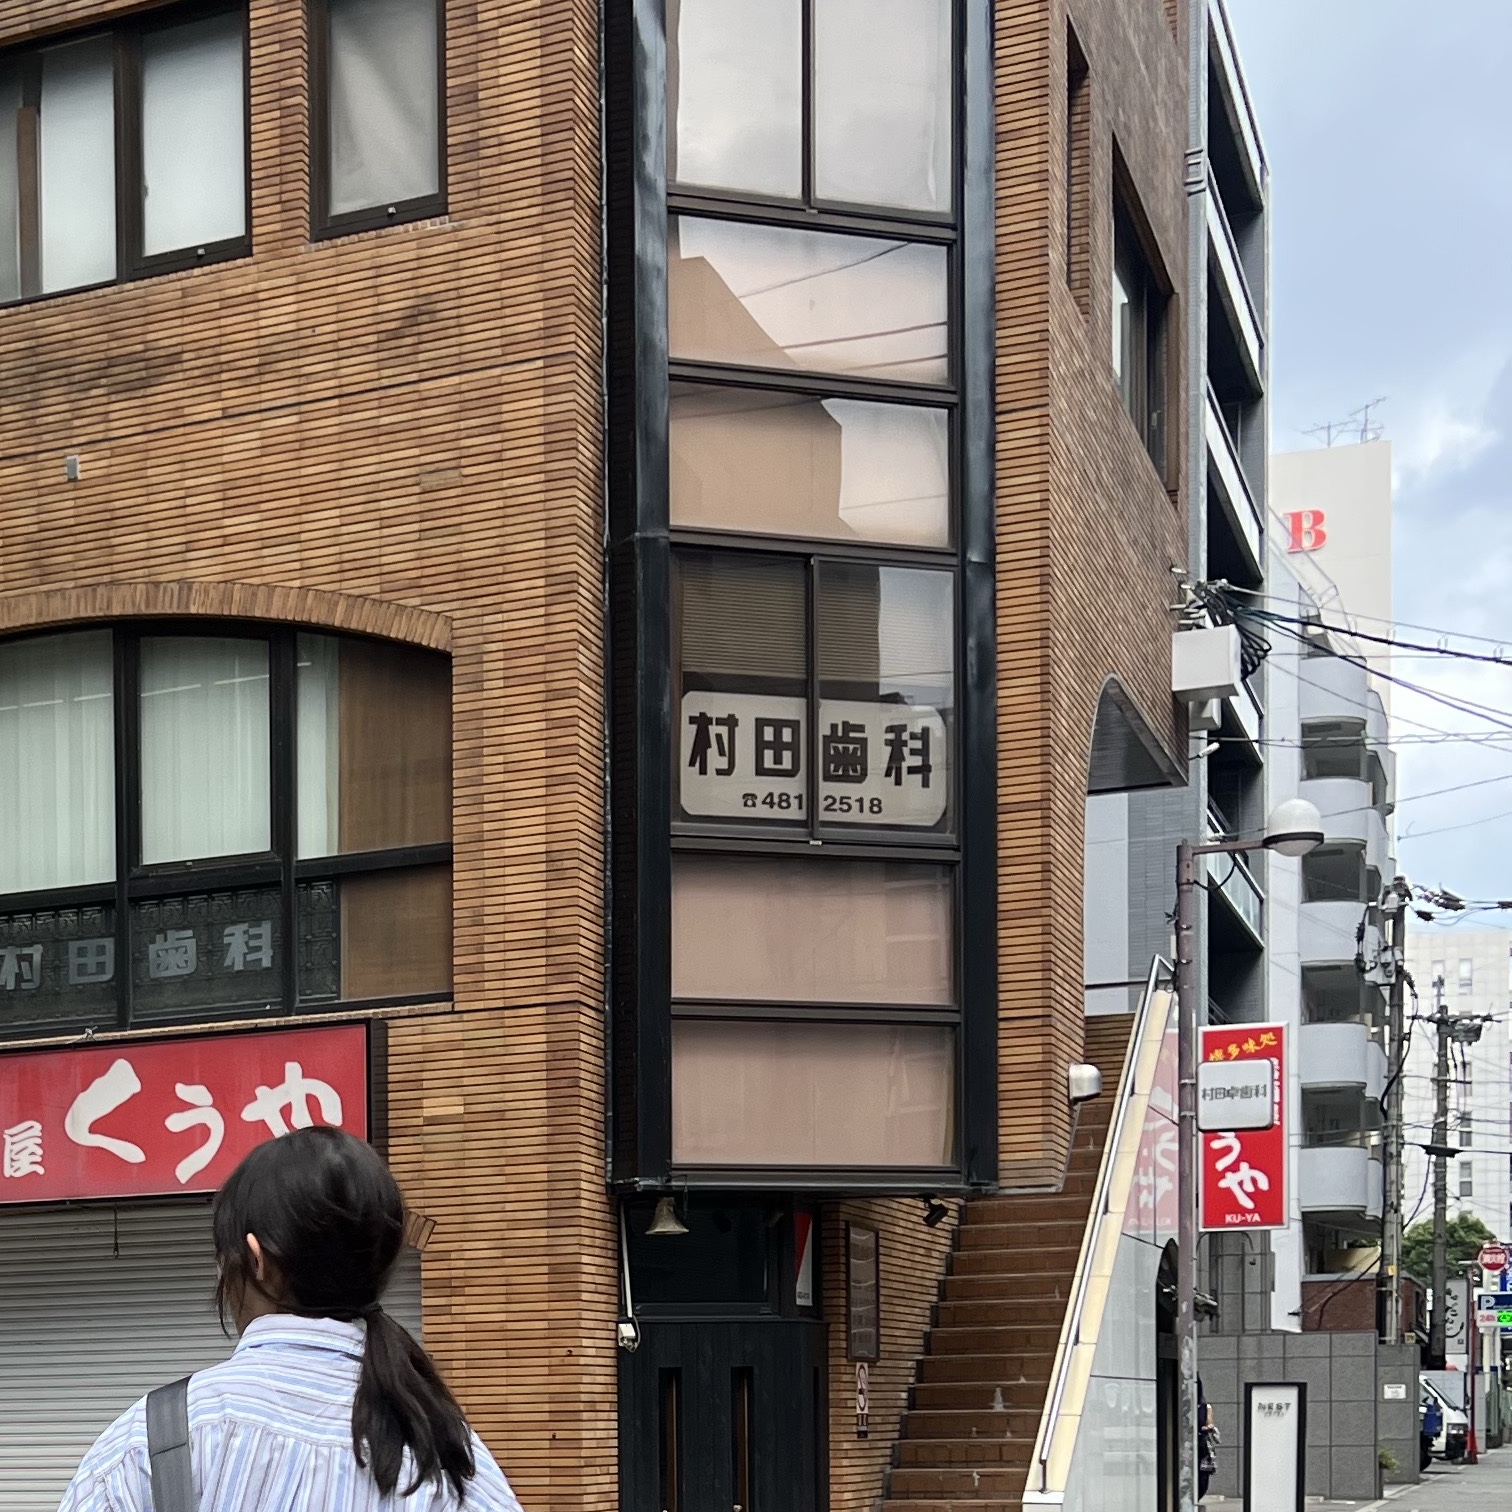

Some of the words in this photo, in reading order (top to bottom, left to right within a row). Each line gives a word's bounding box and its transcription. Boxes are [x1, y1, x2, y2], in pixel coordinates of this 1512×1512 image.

[1283, 510, 1327, 553] B
[688, 711, 933, 788] 村田歯科
[762, 792, 804, 810] 481
[823, 794, 883, 814] 2518
[64, 1058, 343, 1184] くうや
[1225, 1213, 1261, 1224] KU-YA
[1481, 1296, 1495, 1310] P
